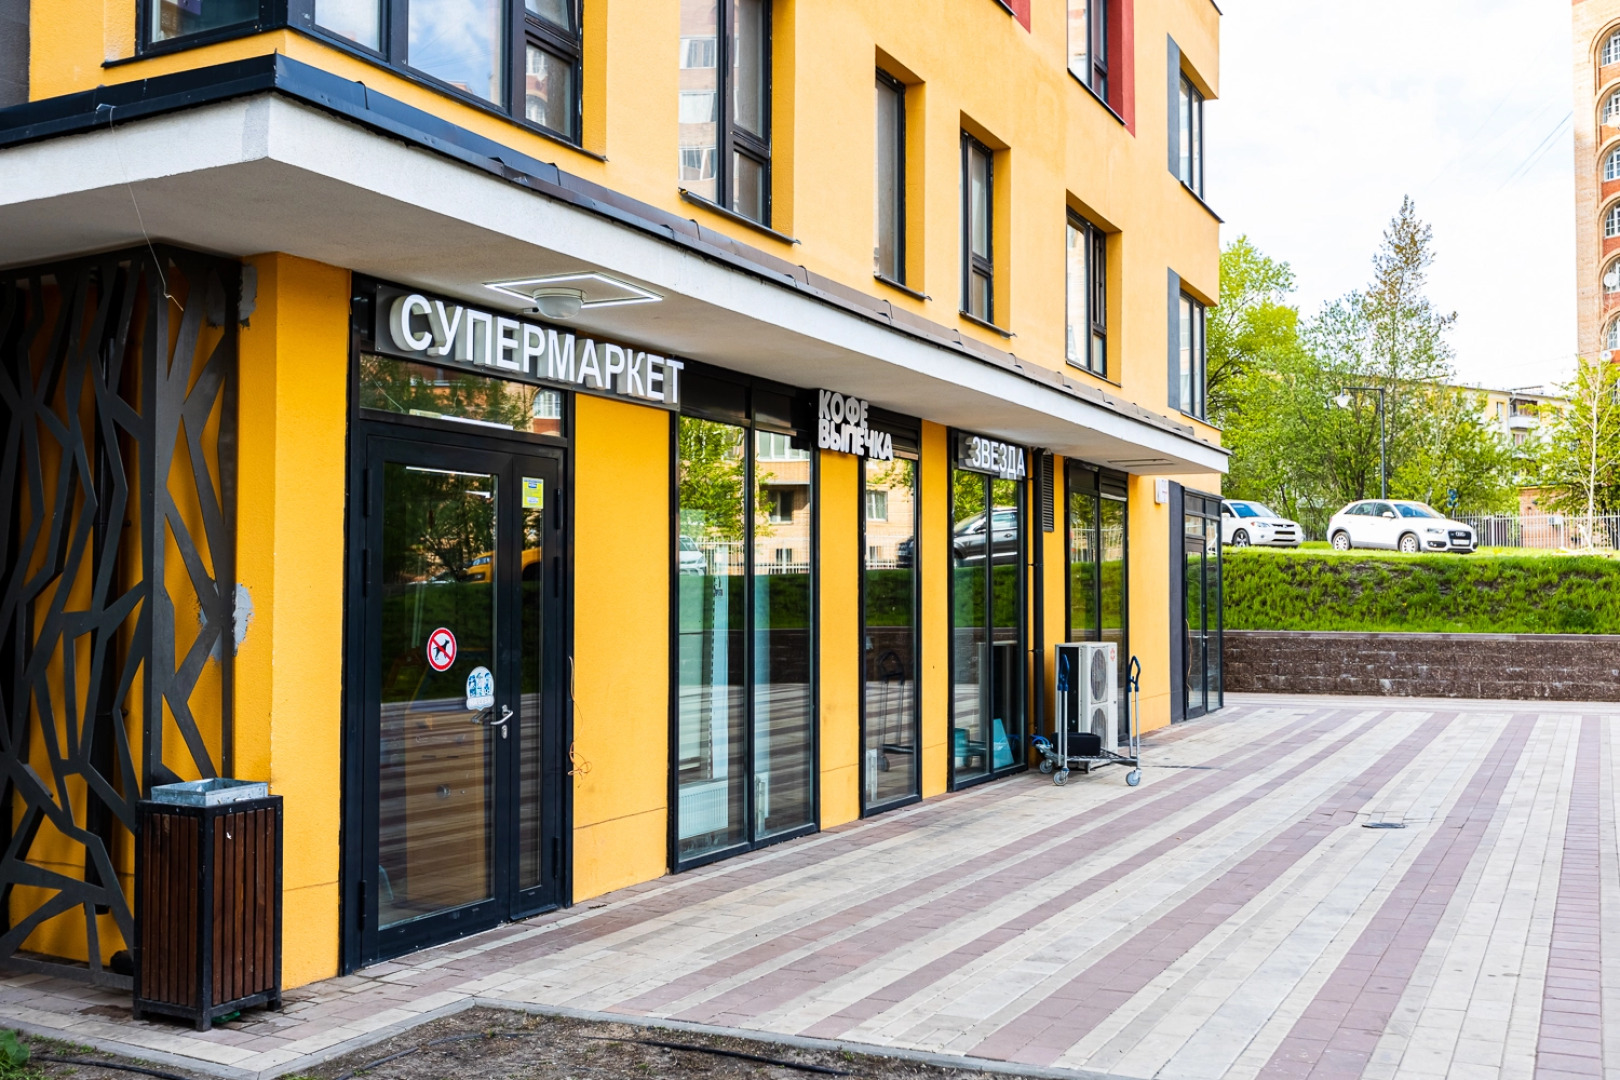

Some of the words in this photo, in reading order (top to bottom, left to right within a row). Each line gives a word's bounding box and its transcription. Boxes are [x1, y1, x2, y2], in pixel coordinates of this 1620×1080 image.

[392, 294, 684, 404] СУПЕРМАРКЕТ
[818, 389, 869, 428] КОФЕ
[818, 418, 893, 461] ВЫПЕЧКА
[967, 436, 1026, 480] ЗВЕЗДА
